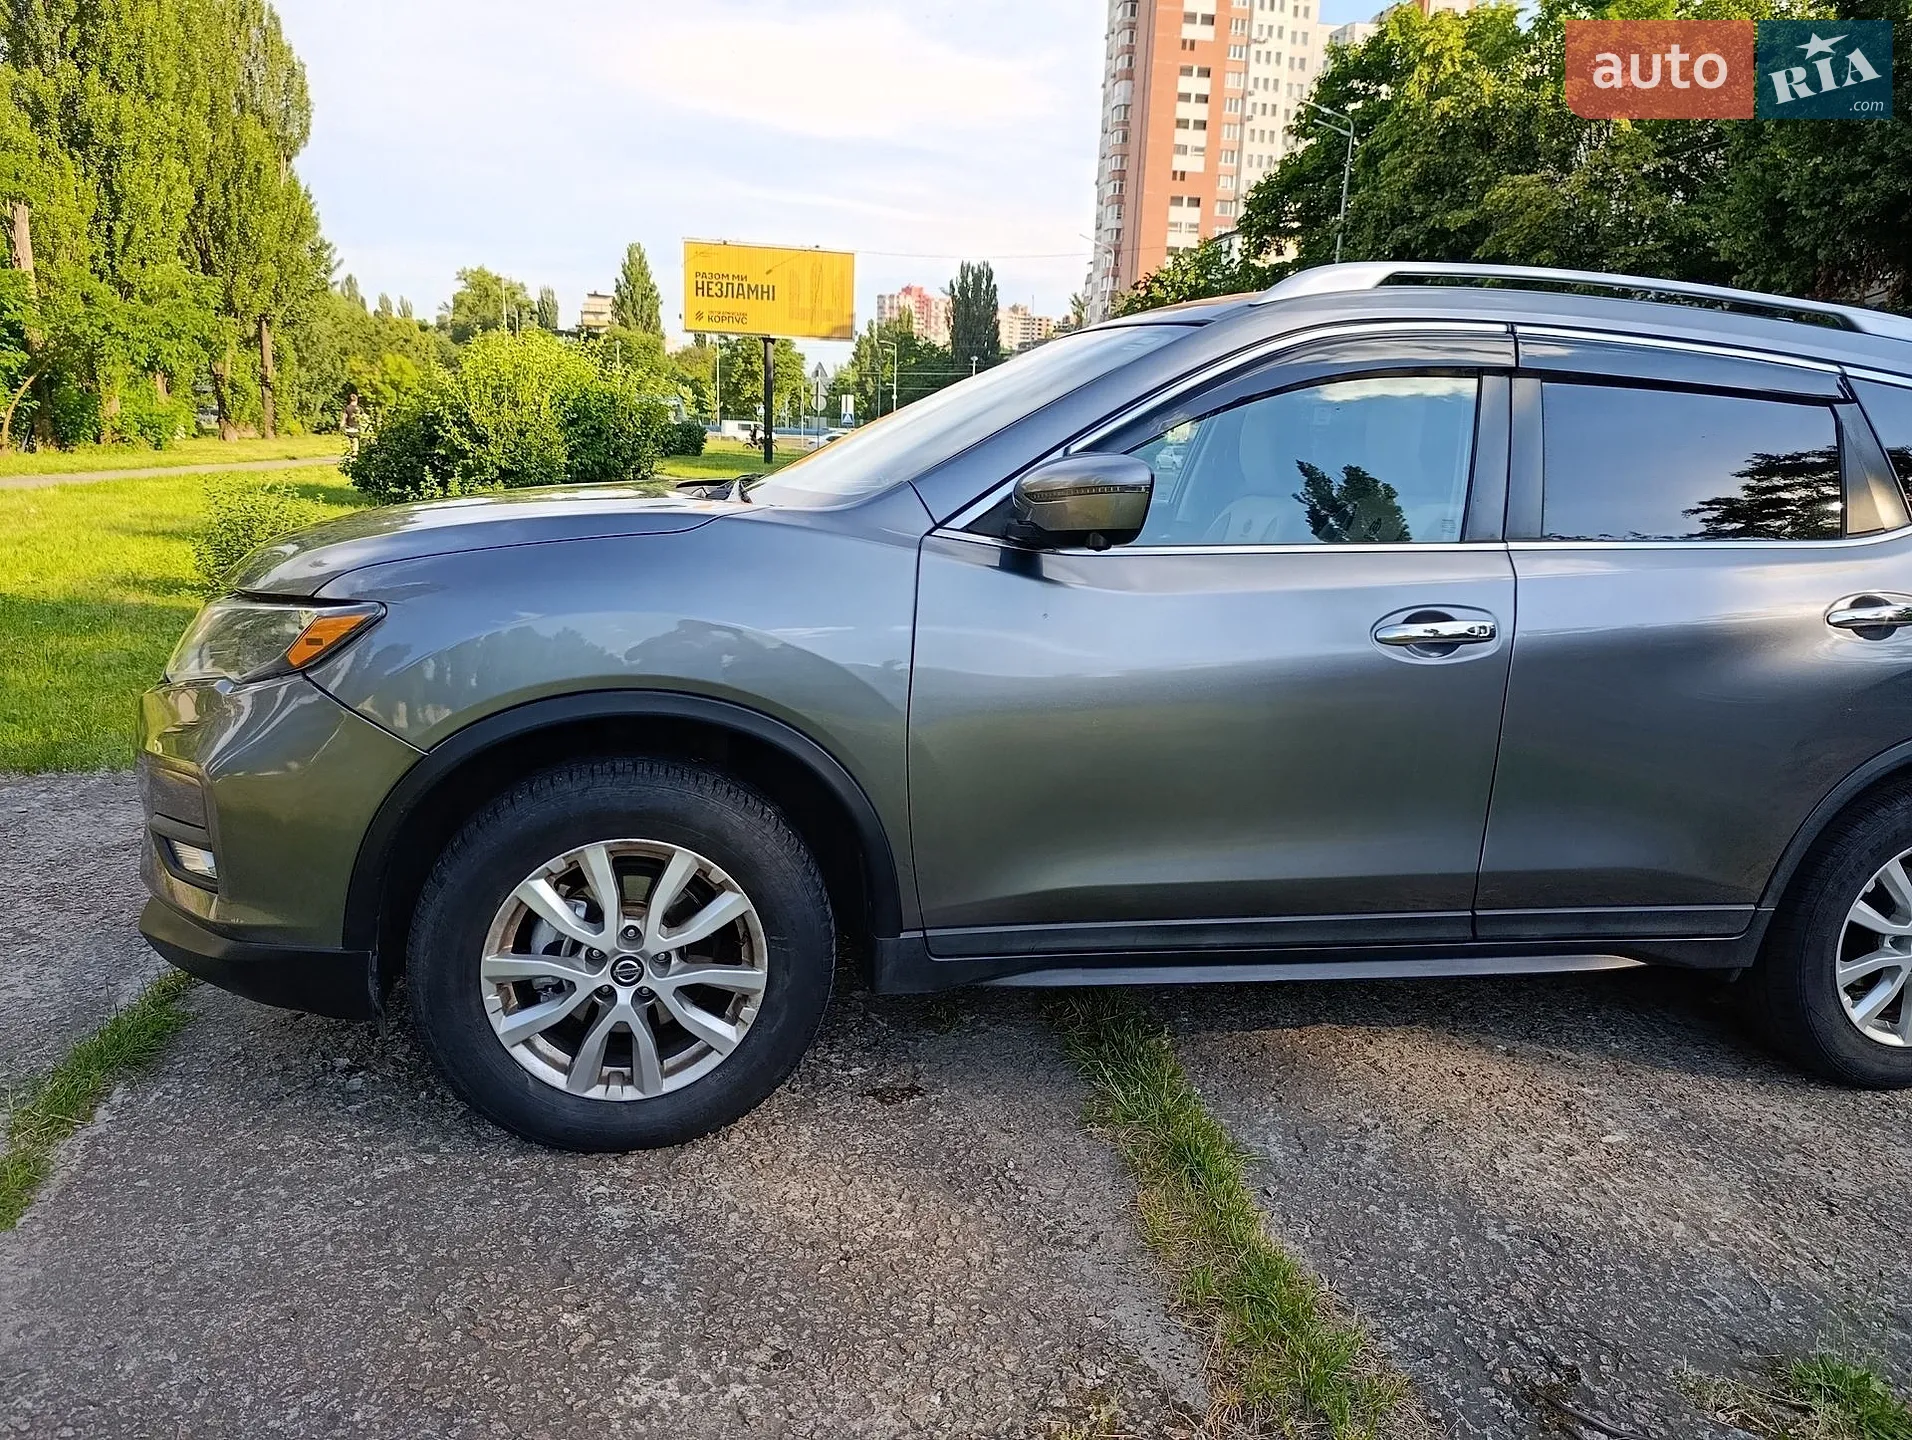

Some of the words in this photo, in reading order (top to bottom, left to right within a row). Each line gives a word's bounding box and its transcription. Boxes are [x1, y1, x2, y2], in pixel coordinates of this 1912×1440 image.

[695, 271, 730, 281] РАЗОМ
[732, 274, 748, 282] МИ
[695, 280, 776, 302] НЕЗЛАМНІ
[707, 315, 748, 326] КОРПУС
